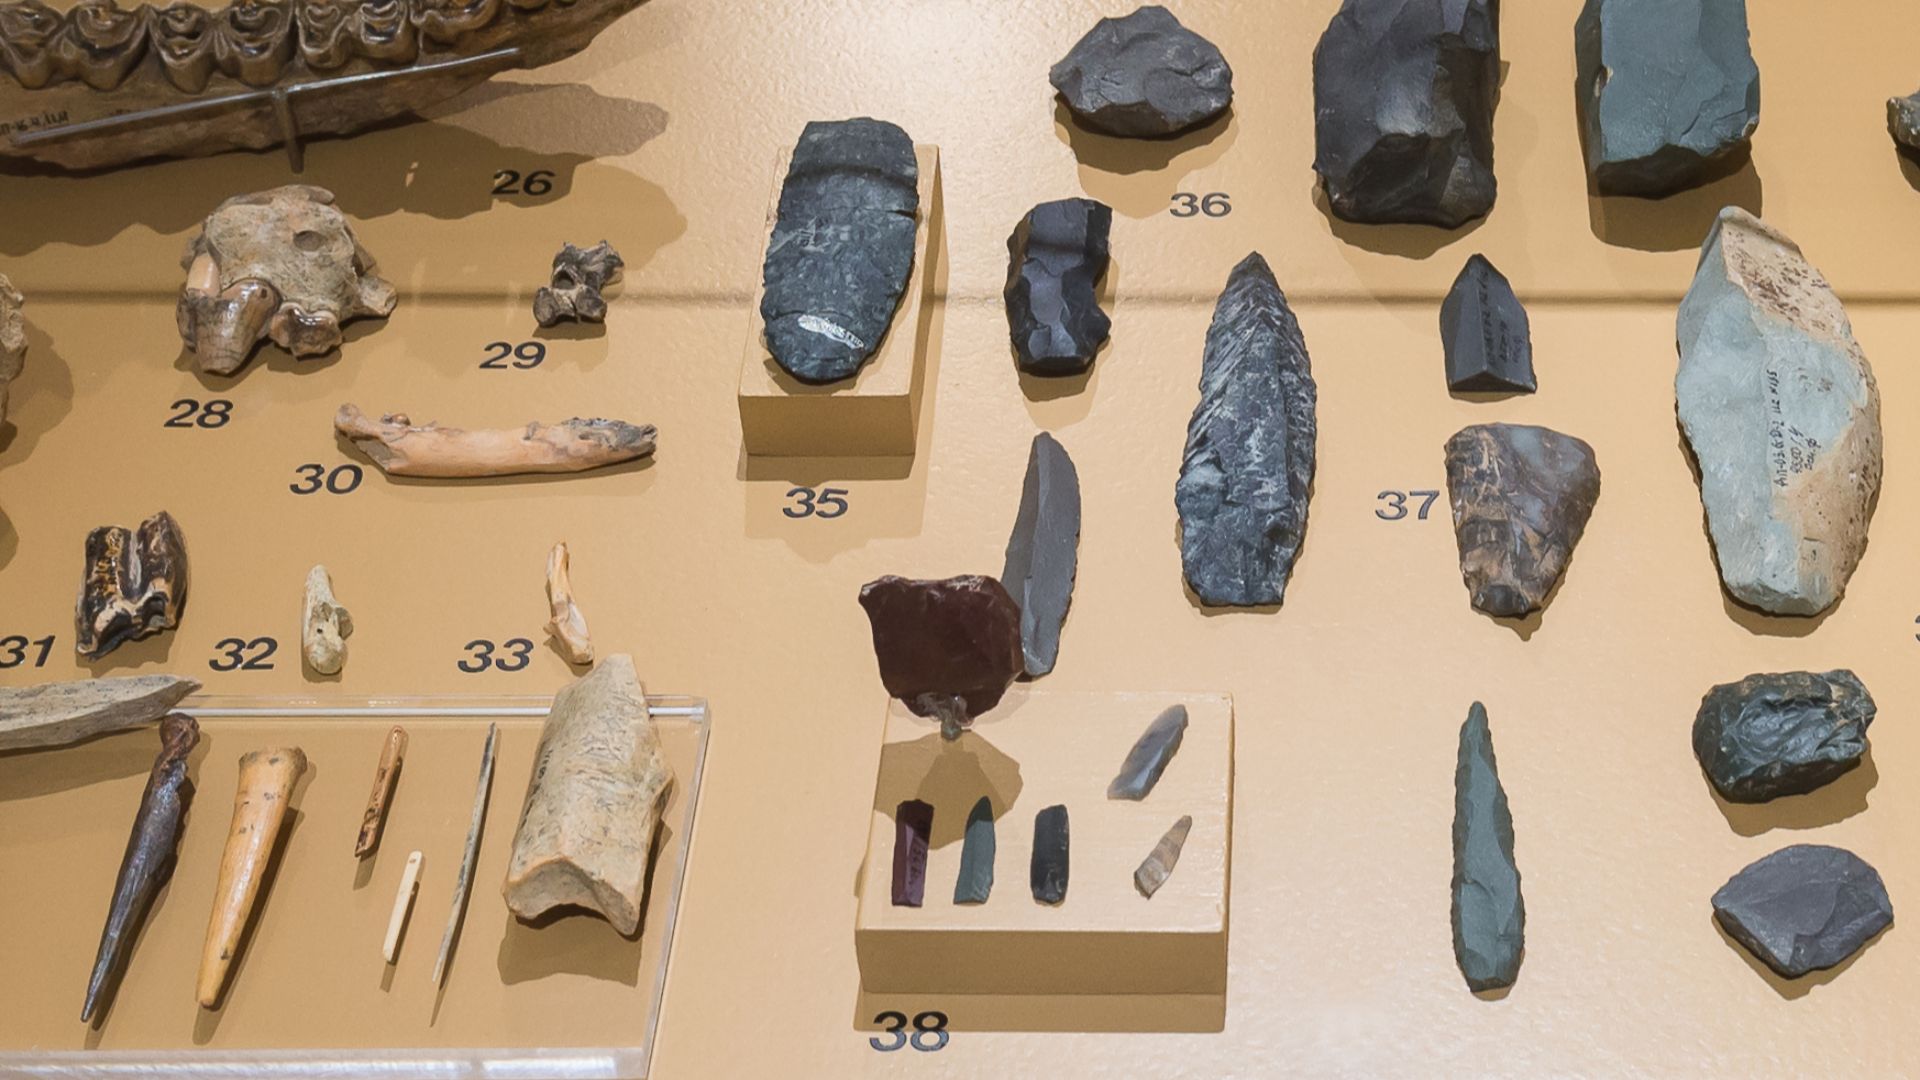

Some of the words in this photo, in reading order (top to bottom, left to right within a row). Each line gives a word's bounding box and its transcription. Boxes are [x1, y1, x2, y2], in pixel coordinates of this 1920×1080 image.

[492, 169, 555, 196] 26
[1169, 193, 1232, 217] 36
[479, 341, 546, 369] 29
[163, 398, 234, 429] 28
[289, 463, 363, 495] 30
[782, 487, 849, 519] 35
[1375, 491, 1440, 521] 37
[0, 635, 56, 669] 31
[208, 638, 278, 672] 32
[457, 639, 534, 673] 33
[869, 1010, 950, 1052] 38
